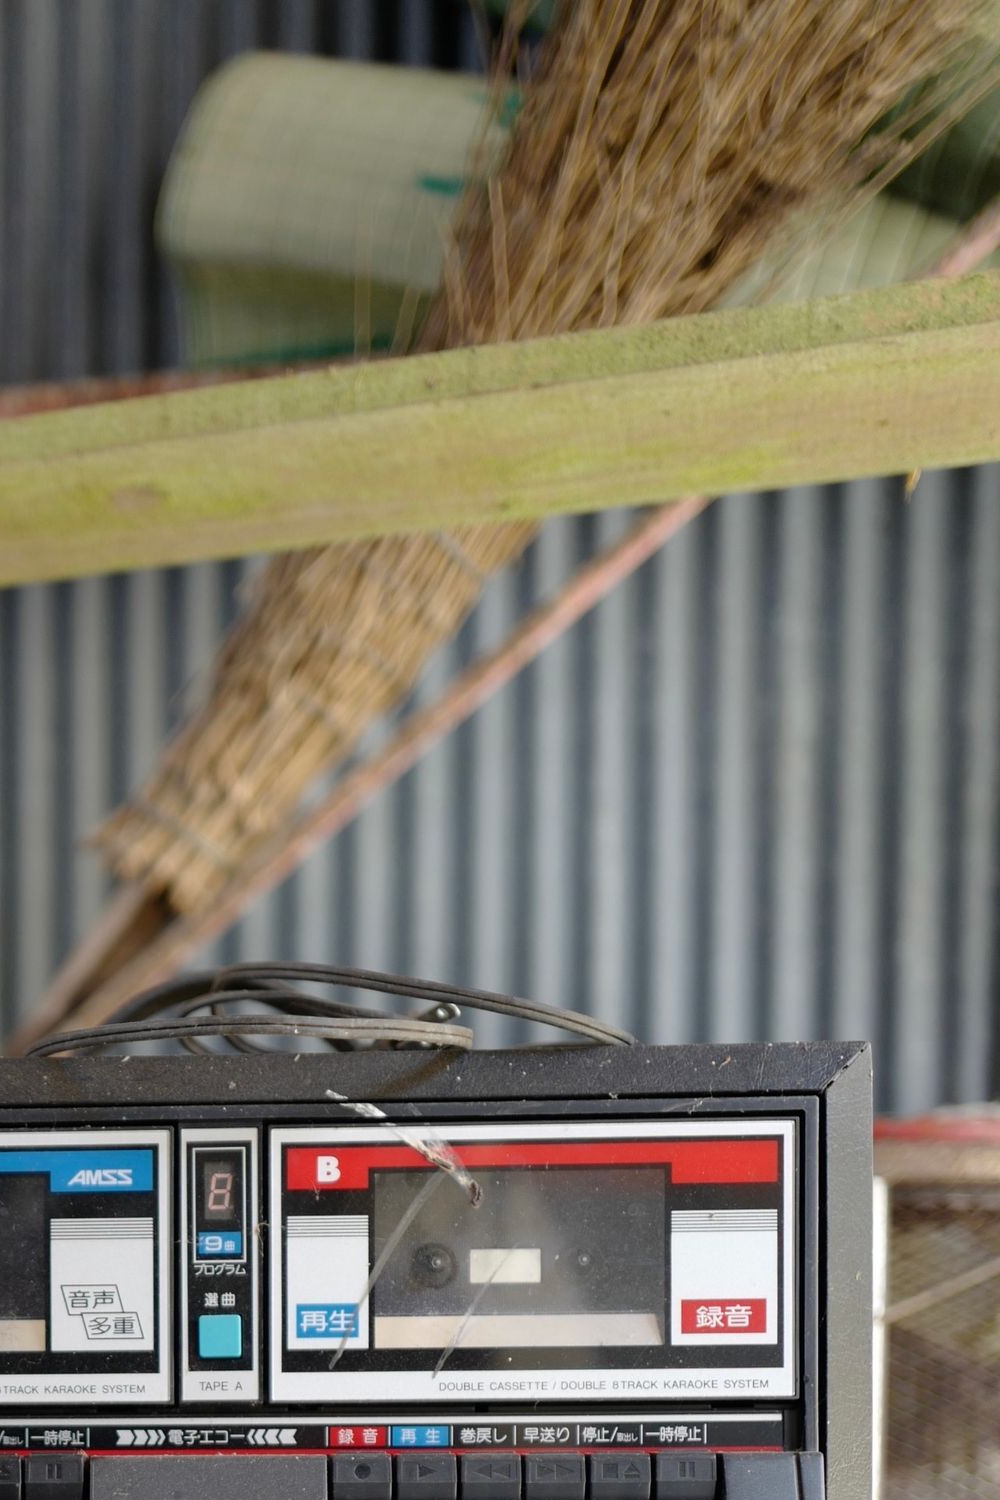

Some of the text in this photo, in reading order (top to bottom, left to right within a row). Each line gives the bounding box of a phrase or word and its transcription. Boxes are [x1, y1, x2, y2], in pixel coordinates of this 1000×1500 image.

[68, 1169, 133, 1185] AMSS
[317, 1156, 341, 1183] B
[194, 1264, 246, 1275] プログラム
[68, 1290, 116, 1309] 音声
[204, 1292, 236, 1307] 選曲
[300, 1309, 356, 1333] 再生
[696, 1304, 752, 1328] 録音
[88, 1316, 135, 1335] 多重
[44, 1385, 97, 1394] KARAOKE
[102, 1384, 146, 1394] SYSTEM
[199, 1381, 243, 1391] TAPE A
[439, 1382, 484, 1392] DOUBLE
[489, 1381, 548, 1391] CASSETTE
[561, 1381, 607, 1391] DOUBLE
[663, 1380, 718, 1389] KARAOKE
[723, 1379, 769, 1389] SYSTEM
[30, 1430, 85, 1445] 一時停止
[168, 1428, 246, 1445] 電子エコー
[338, 1428, 378, 1444] 録音
[401, 1428, 441, 1444] 再生
[460, 1427, 507, 1443] 巻戻し
[523, 1426, 570, 1443] 早送り
[645, 1426, 702, 1442] 一時停止
